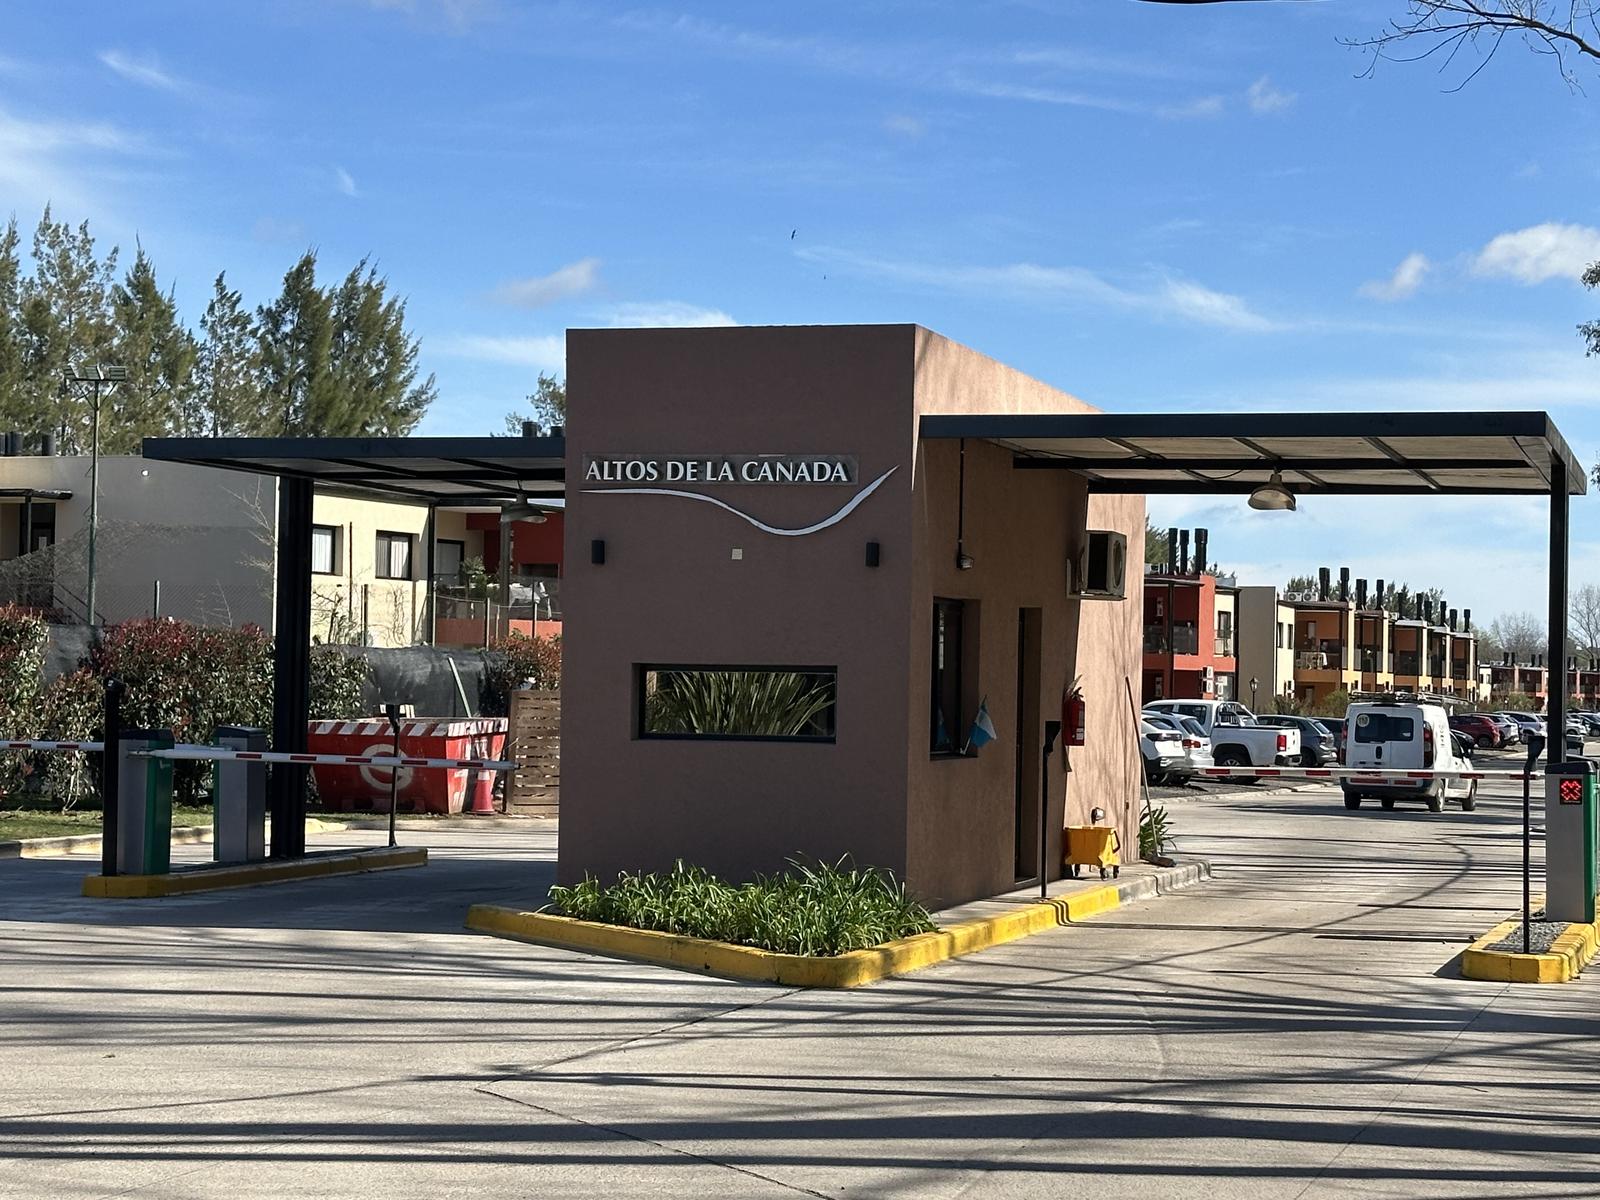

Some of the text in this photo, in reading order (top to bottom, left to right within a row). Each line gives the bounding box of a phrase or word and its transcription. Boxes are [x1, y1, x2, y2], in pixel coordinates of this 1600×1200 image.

[585, 460, 849, 482] ALTOS DE LA CANADA
